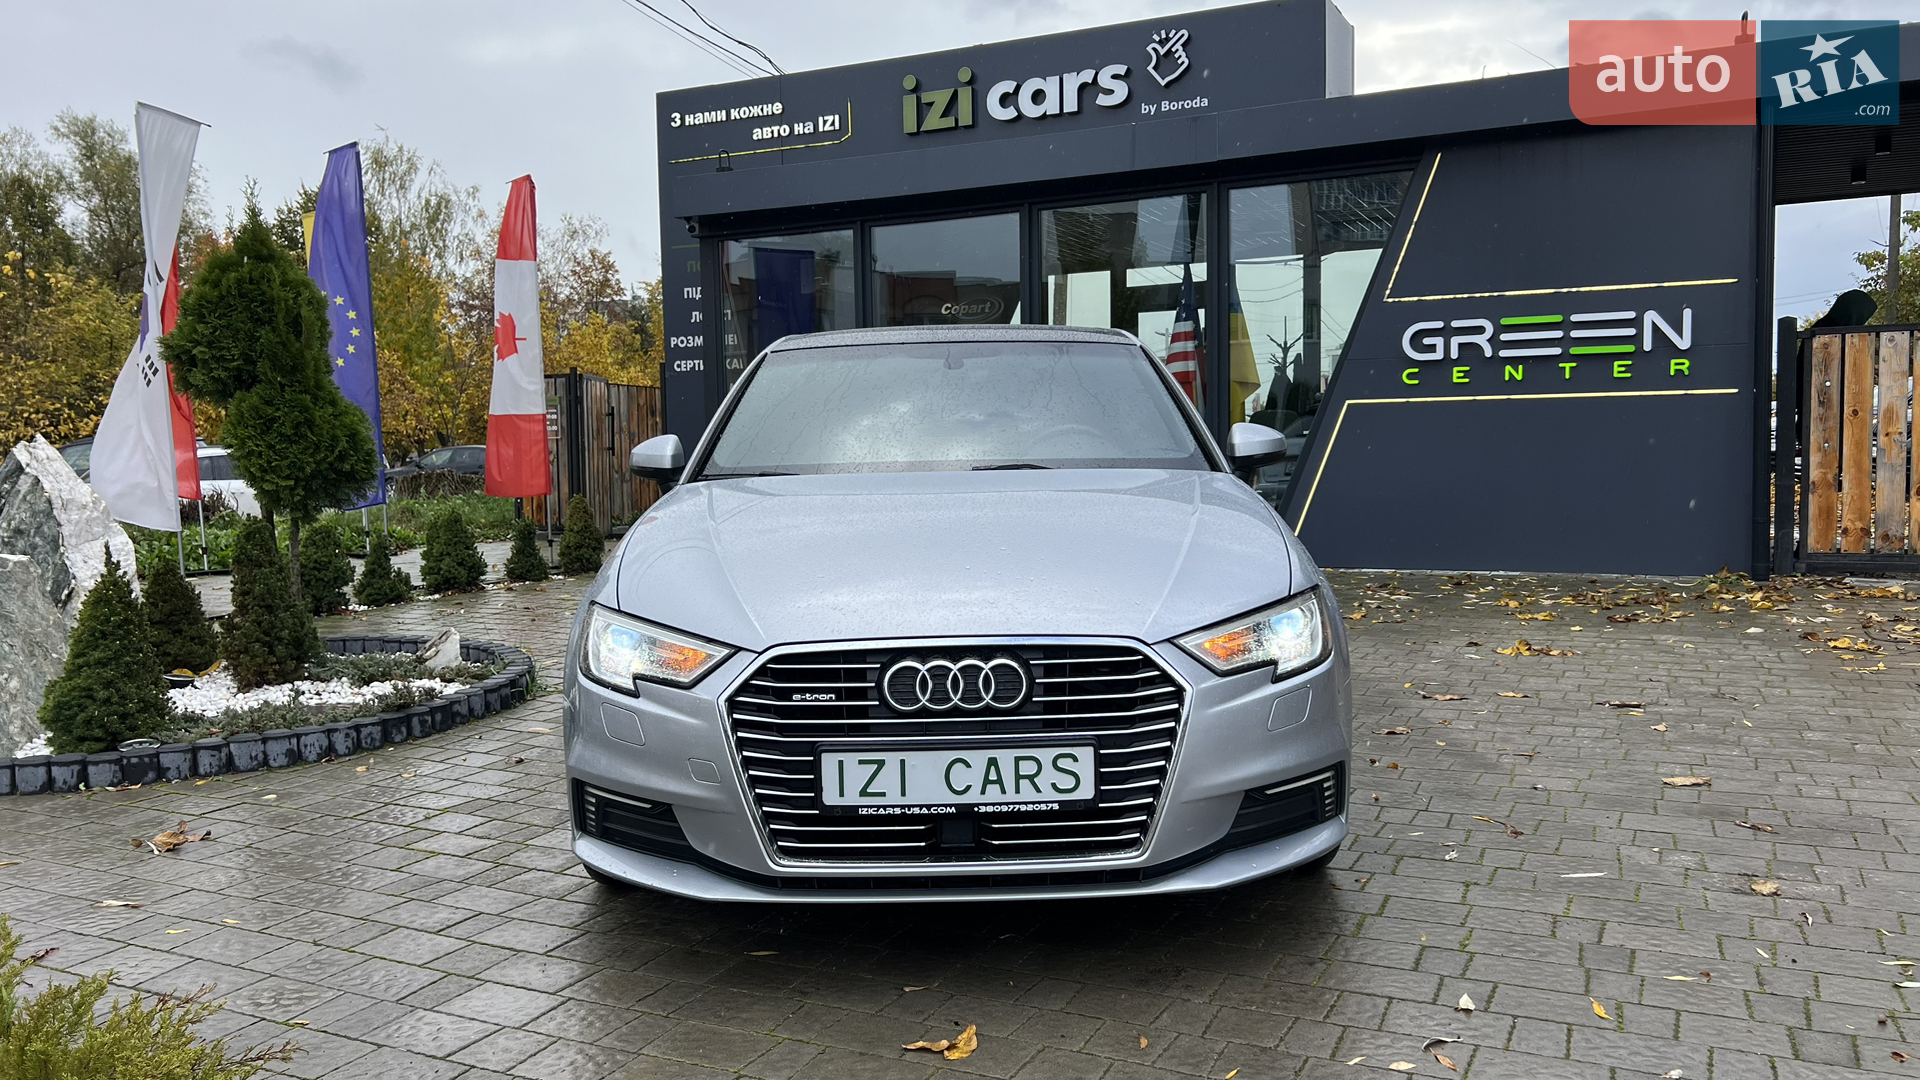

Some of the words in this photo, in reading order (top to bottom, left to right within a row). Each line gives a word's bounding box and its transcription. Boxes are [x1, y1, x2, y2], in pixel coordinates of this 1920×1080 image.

[902, 66, 974, 134] izi
[986, 63, 1130, 121] cars
[1141, 101, 1157, 115] by
[1160, 96, 1209, 112] Boroda
[684, 109, 727, 126] нами
[730, 101, 784, 121] кожне
[752, 123, 790, 141] авто
[793, 121, 814, 135] на
[818, 114, 840, 132] IZI
[941, 301, 992, 317] Copart
[1402, 308, 1692, 361] GREEN
[1402, 358, 1690, 384] CENTER
[838, 758, 906, 798] IZI
[944, 752, 1081, 796] CARS
[858, 806, 956, 815] IZICARS-USA.COM
[973, 802, 1060, 813] +380977920575
